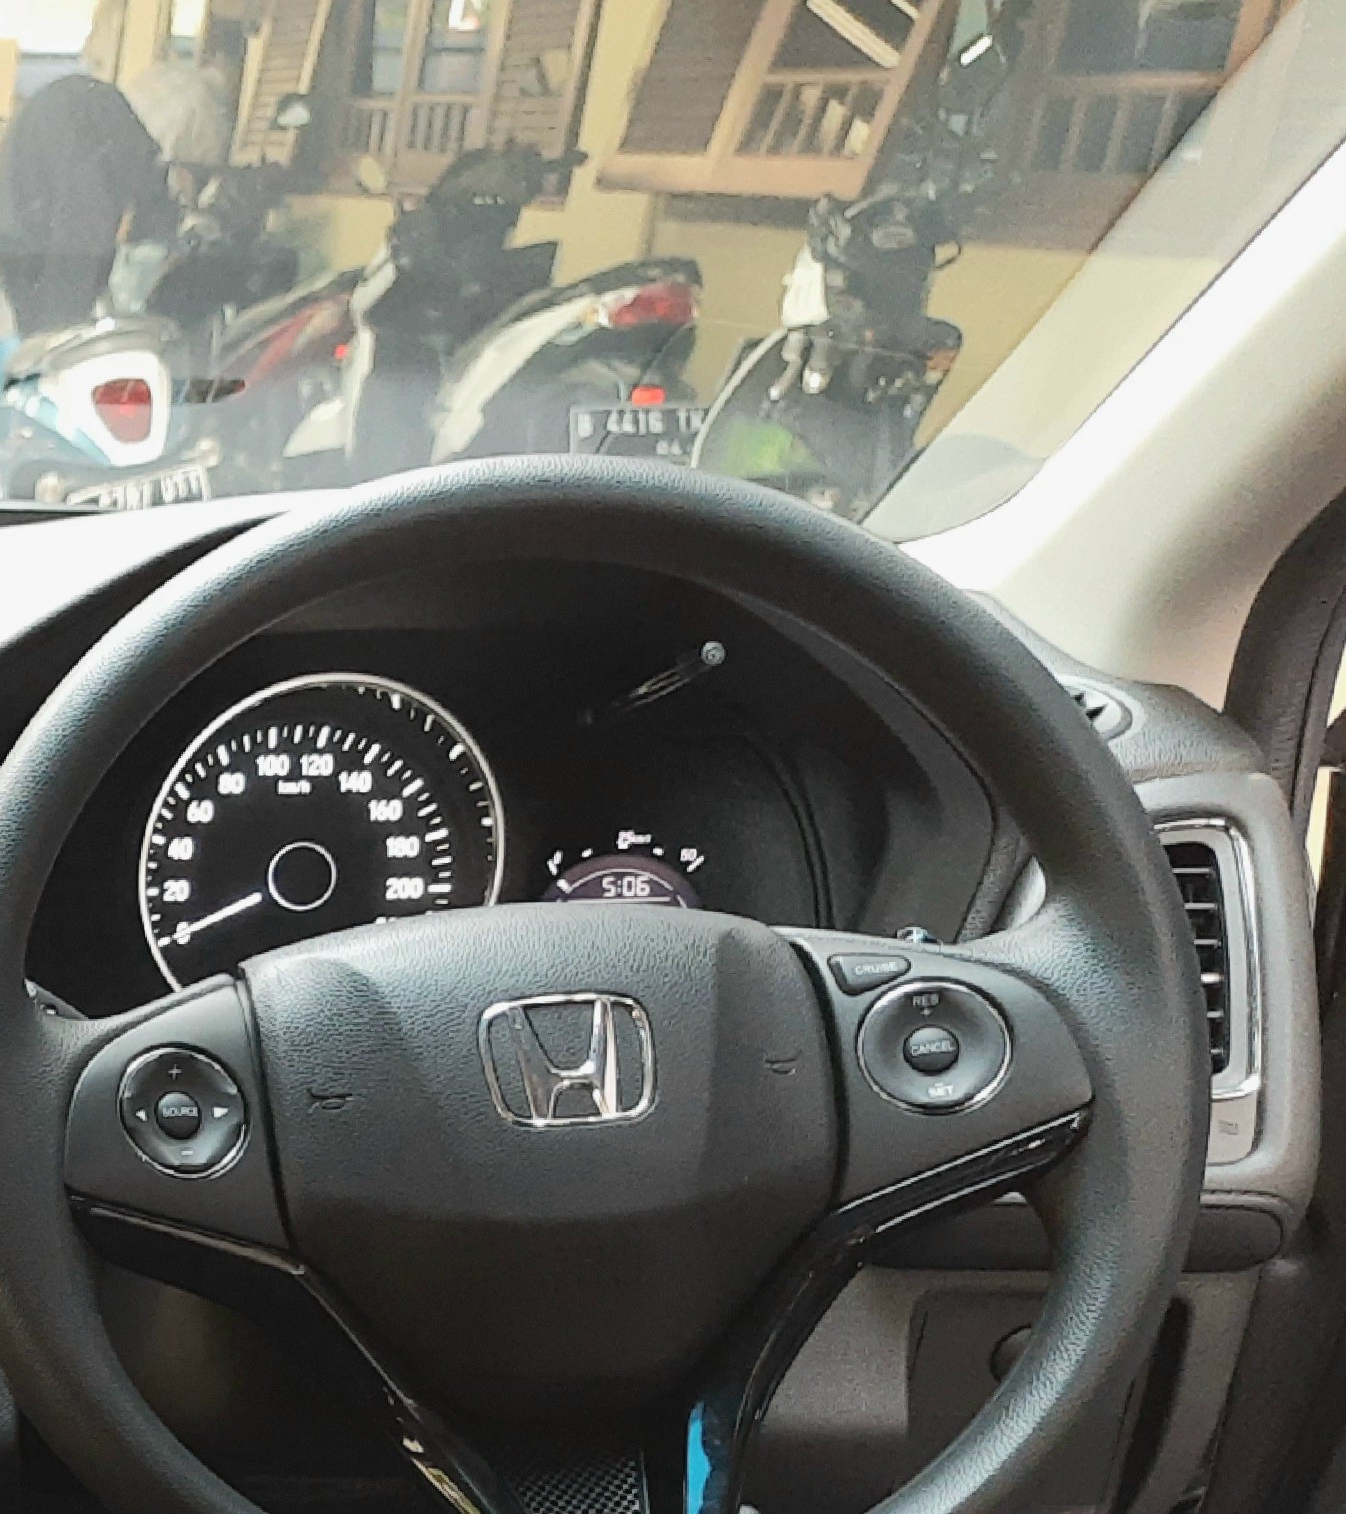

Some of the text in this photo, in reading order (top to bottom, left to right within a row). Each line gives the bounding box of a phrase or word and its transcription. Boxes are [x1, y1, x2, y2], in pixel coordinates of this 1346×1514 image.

[257, 755, 290, 777] 100
[300, 755, 334, 777] 120
[217, 772, 245, 795] 80
[338, 771, 373, 794] 140
[187, 800, 214, 824] 60
[368, 799, 403, 822] 160
[167, 836, 195, 860] 40
[385, 836, 421, 858] 180
[163, 879, 191, 902] 20
[385, 877, 424, 901] 200
[601, 875, 651, 898] 5:06
[912, 993, 939, 1008] RES
[911, 1041, 956, 1055] CANCEL
[928, 1086, 954, 1097] SET
